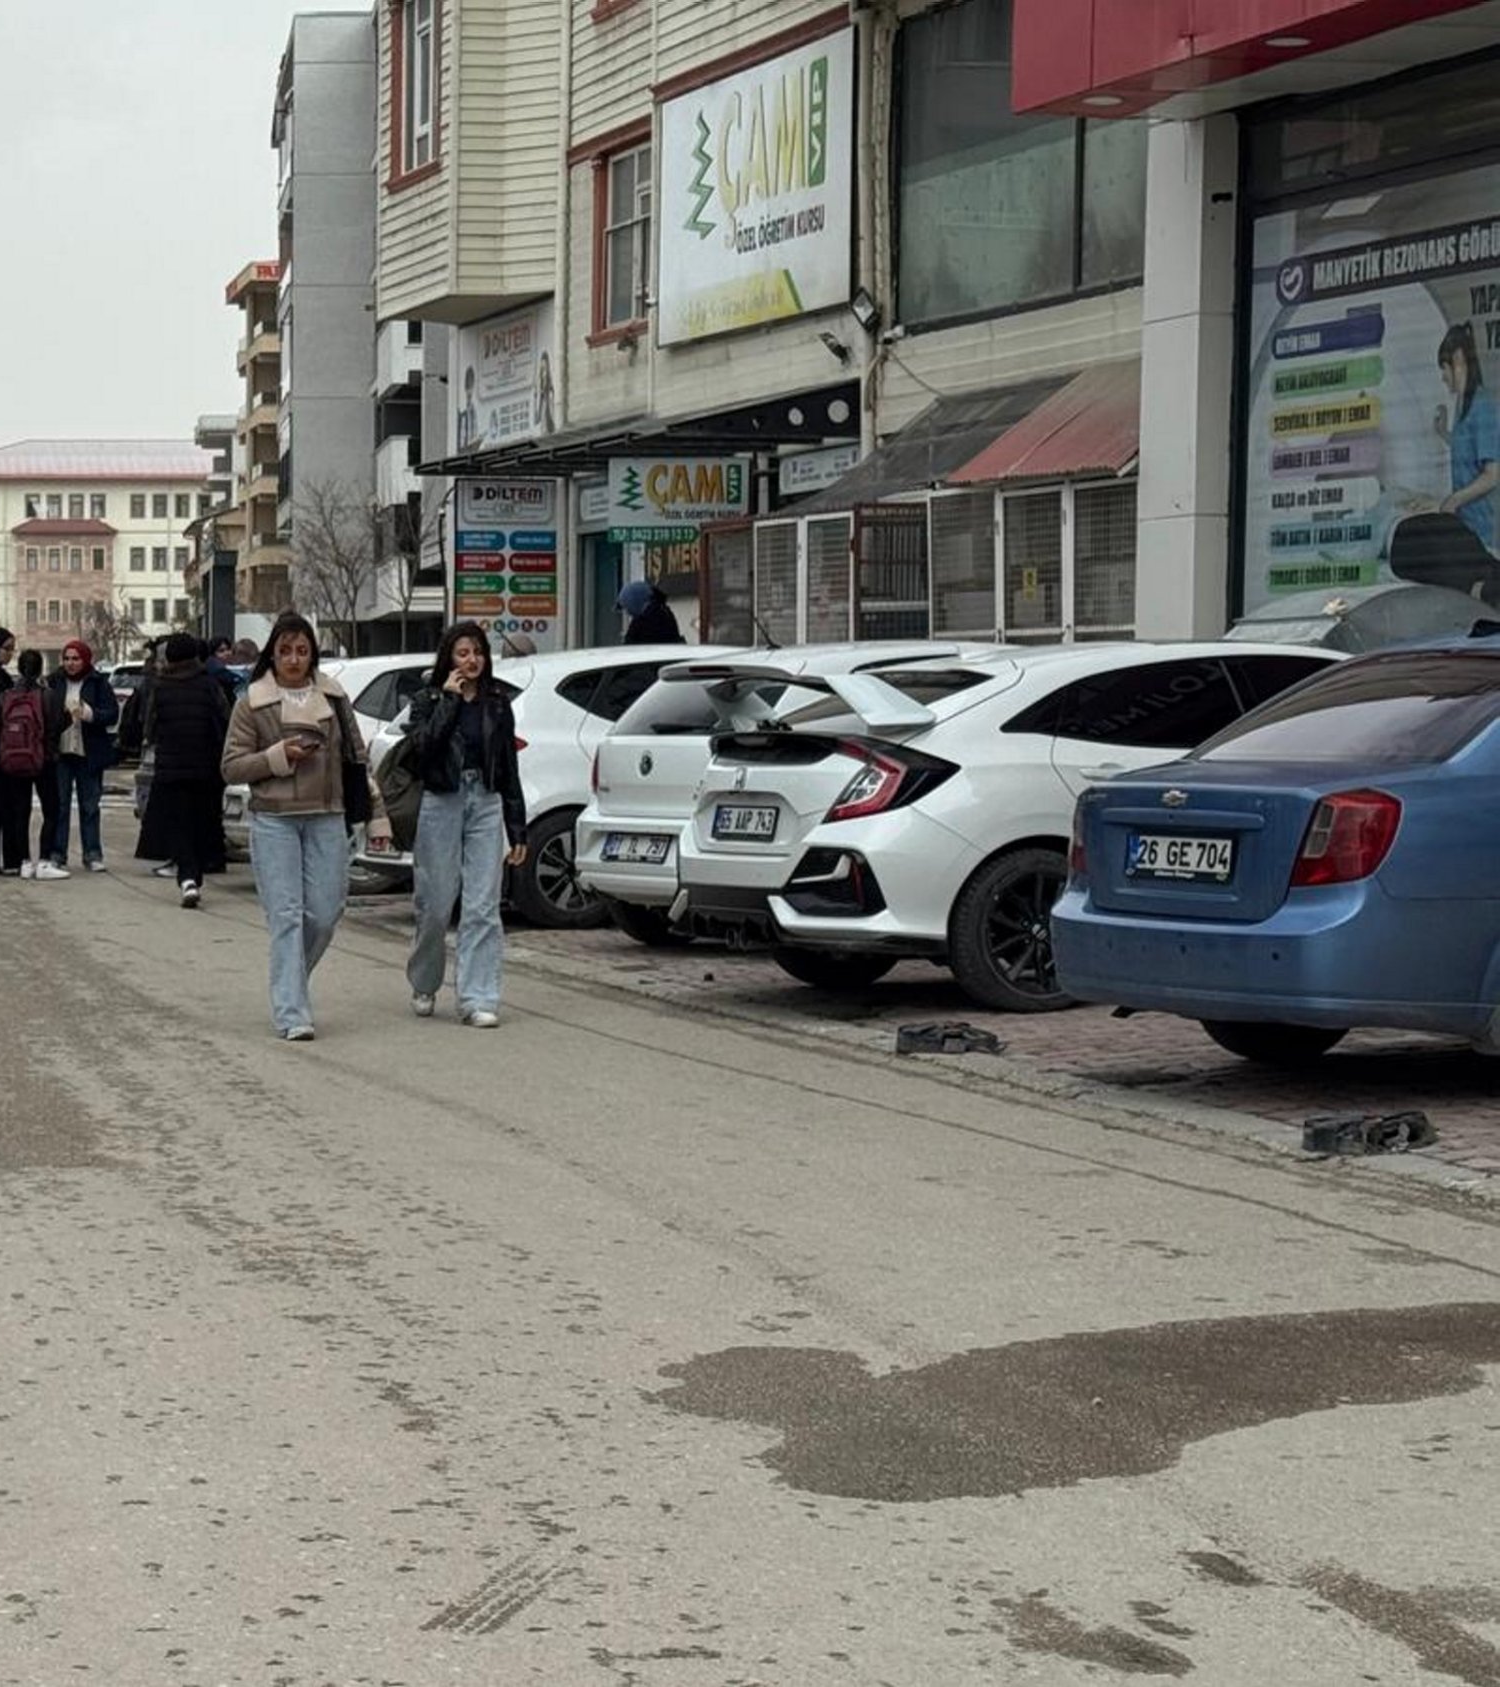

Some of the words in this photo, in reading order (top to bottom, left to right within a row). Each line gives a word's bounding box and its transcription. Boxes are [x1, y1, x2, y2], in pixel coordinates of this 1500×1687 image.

[717, 66, 805, 246] ÇAM
[1313, 246, 1381, 291] MANYETİK
[1383, 234, 1457, 277] REZONANS
[645, 463, 725, 512] ÇAM
[1136, 839, 1159, 865] 26
[1167, 840, 1193, 867] GE
[1195, 842, 1228, 870] 704
